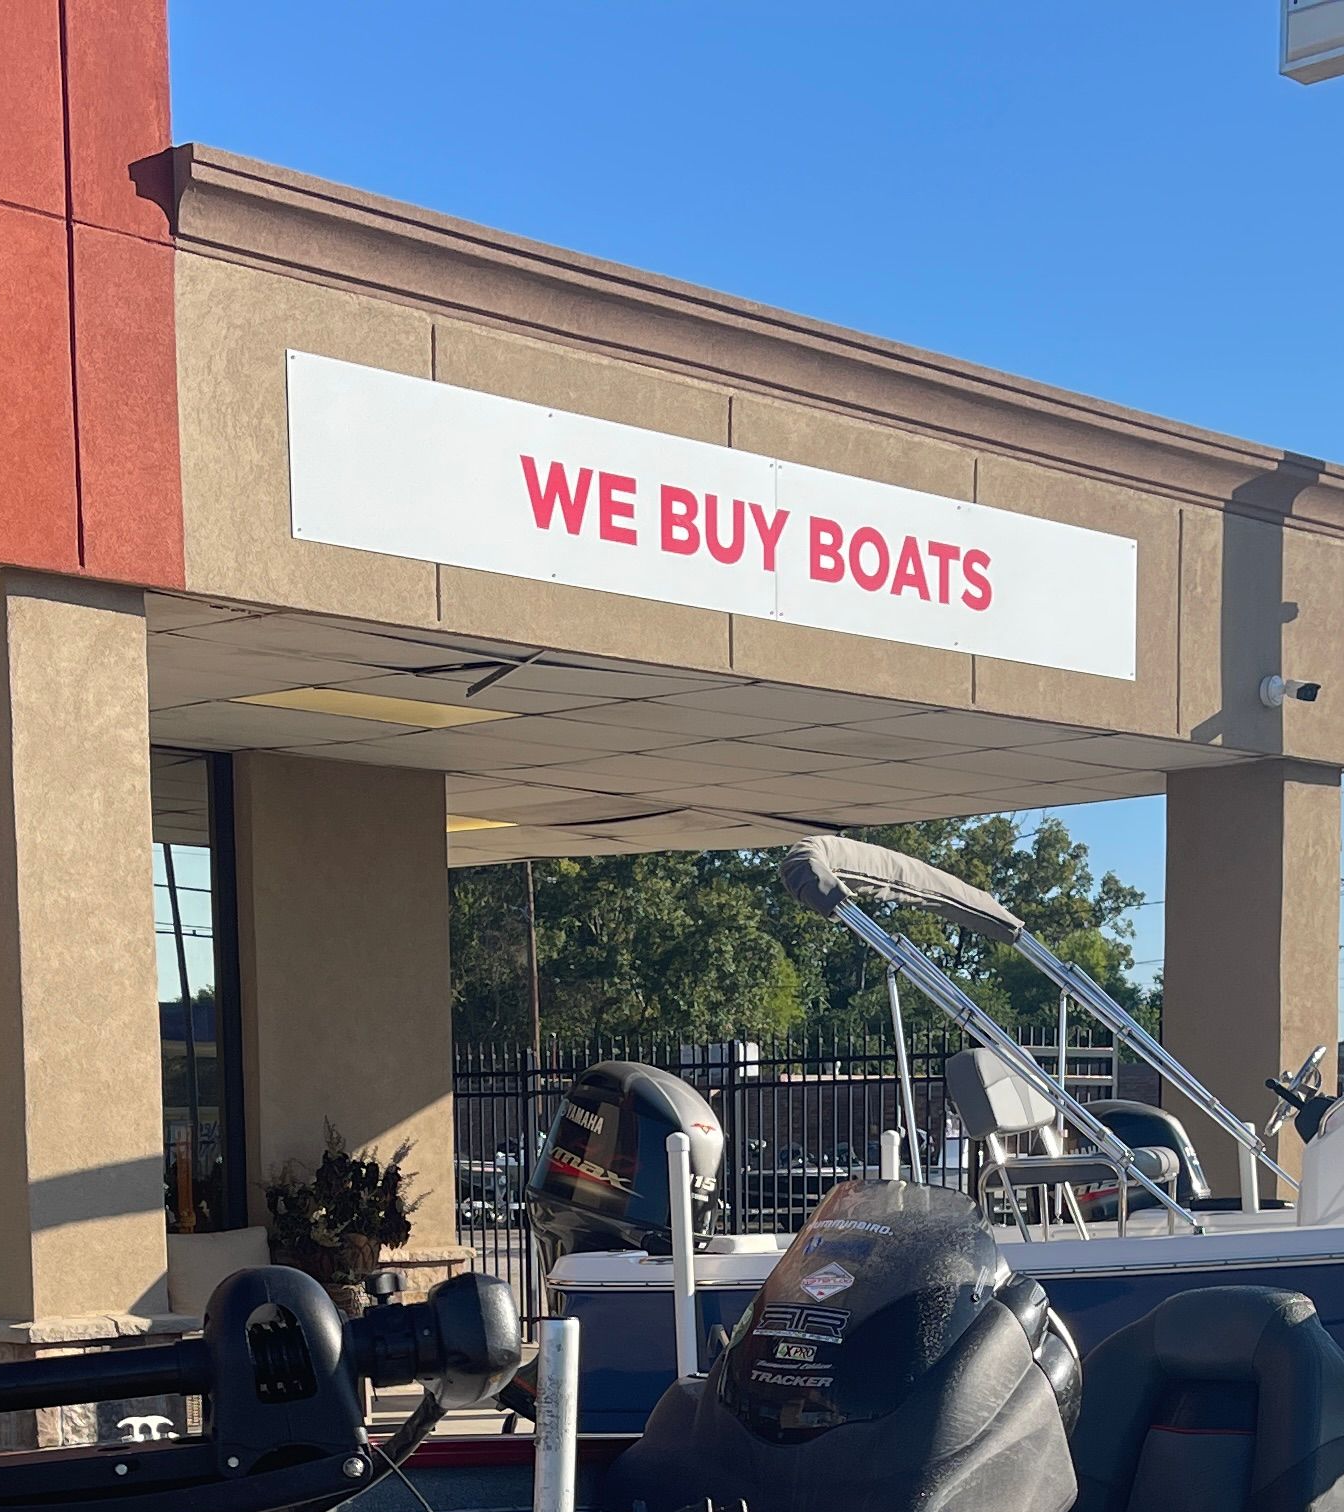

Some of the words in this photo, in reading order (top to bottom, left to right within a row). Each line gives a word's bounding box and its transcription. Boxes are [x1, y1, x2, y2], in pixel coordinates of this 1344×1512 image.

[519, 454, 637, 546] WE
[660, 483, 789, 572] BUY
[808, 516, 994, 612] BOATS
[566, 1102, 605, 1136] YAMAHA
[750, 1369, 834, 1388] TRACKER
